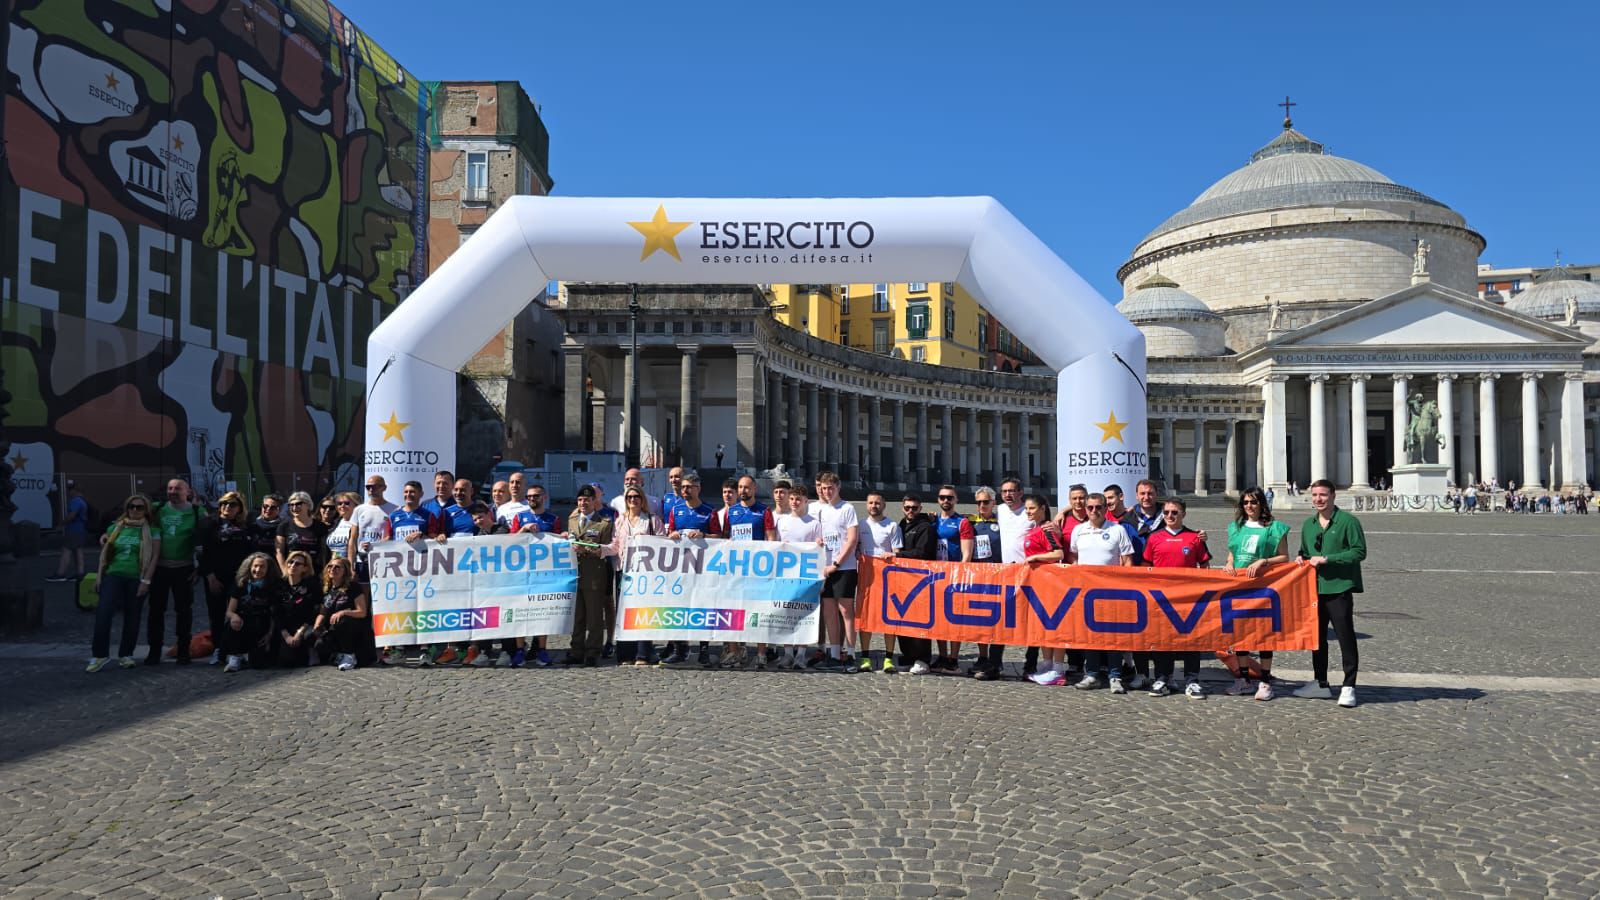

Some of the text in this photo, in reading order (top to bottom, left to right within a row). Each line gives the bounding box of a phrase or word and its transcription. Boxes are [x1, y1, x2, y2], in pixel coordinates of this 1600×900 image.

[88, 84, 134, 114] ESERCITO
[159, 147, 196, 174] ESERCITO
[700, 221, 875, 249] ESERCITO
[701, 253, 873, 264] esercito.difesa.it
[1068, 451, 1147, 468] ESERCITO
[623, 575, 683, 597] 2026
[537, 592, 572, 602] EDIZIONE
[633, 611, 732, 627] MASSIGEN
[943, 583, 1282, 634] GIVOVA
[382, 611, 487, 632] MASSIGEN
